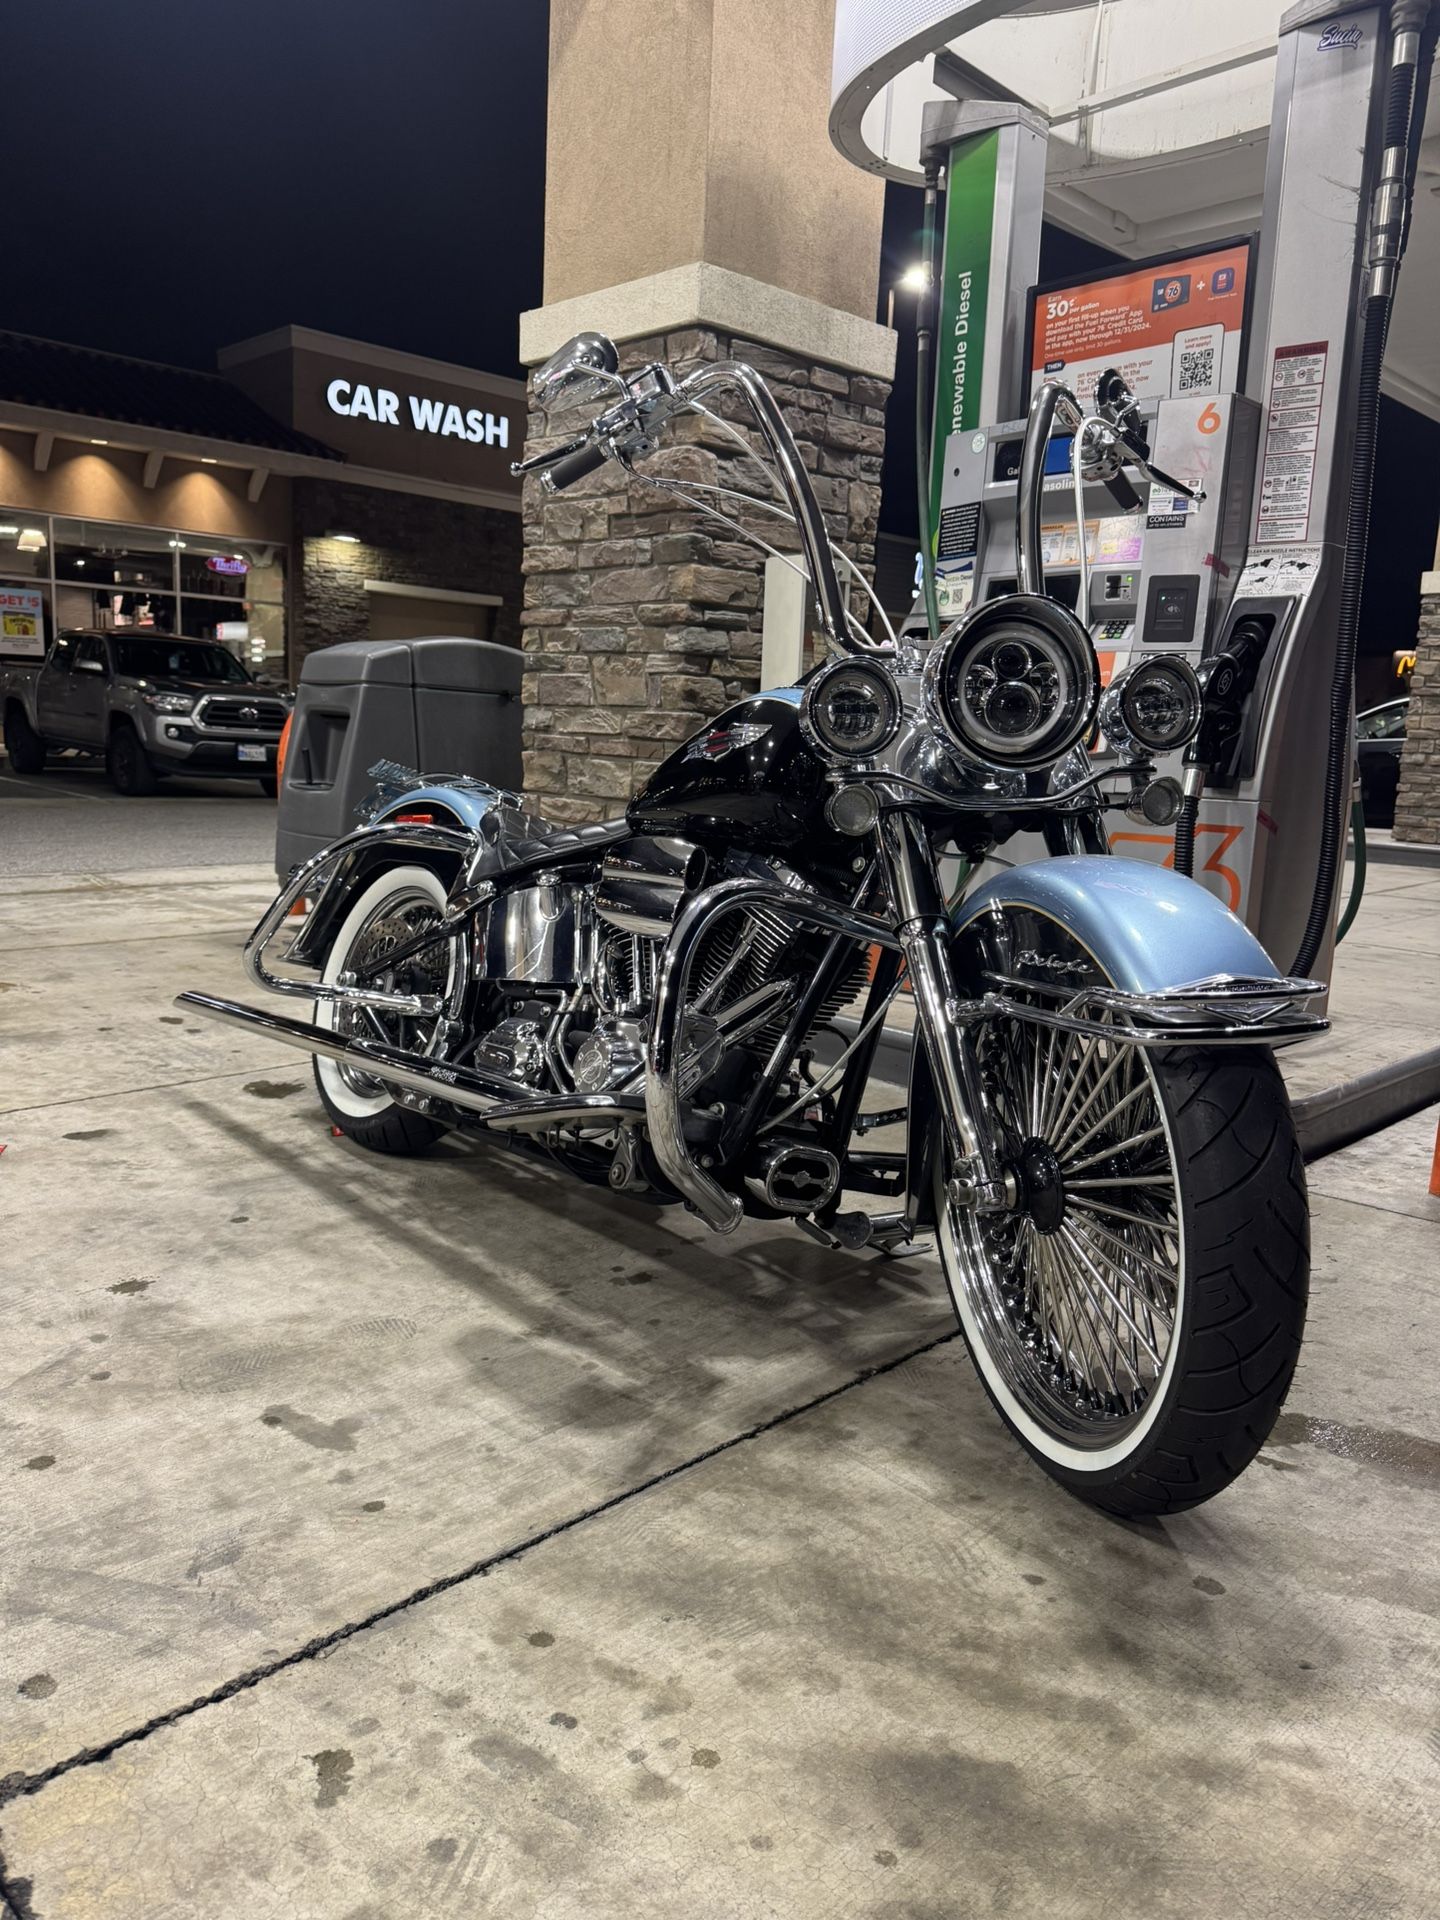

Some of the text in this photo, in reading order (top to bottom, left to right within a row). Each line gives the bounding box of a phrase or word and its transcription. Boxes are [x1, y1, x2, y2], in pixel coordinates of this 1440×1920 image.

[955, 270, 972, 336] Diesel
[1048, 295, 1062, 303] Earn
[1069, 302, 1100, 314] per gallon
[1045, 324, 1074, 337] download
[1074, 322, 1085, 330] the
[1085, 318, 1099, 327] Fuel
[1129, 310, 1143, 319] App
[1055, 319, 1068, 328] your
[1068, 316, 1080, 325] first
[1081, 312, 1099, 321] fill-up
[1100, 308, 1117, 316] when
[1118, 305, 1130, 314] you
[1045, 336, 1056, 344] and
[1069, 330, 1082, 338] with
[1082, 328, 1096, 336] your
[1107, 319, 1126, 329] Credit
[1127, 316, 1144, 325] Card
[1075, 336, 1088, 344] now
[1089, 330, 1113, 341] through
[1047, 362, 1062, 371] THEN
[1138, 359, 1153, 368] your
[327, 379, 509, 449] CAR WASH
[1197, 402, 1221, 435] 6
[1149, 515, 1185, 523] CONTAINS
[0, 594, 24, 606] GET
[1014, 949, 1094, 975] Deluxe
